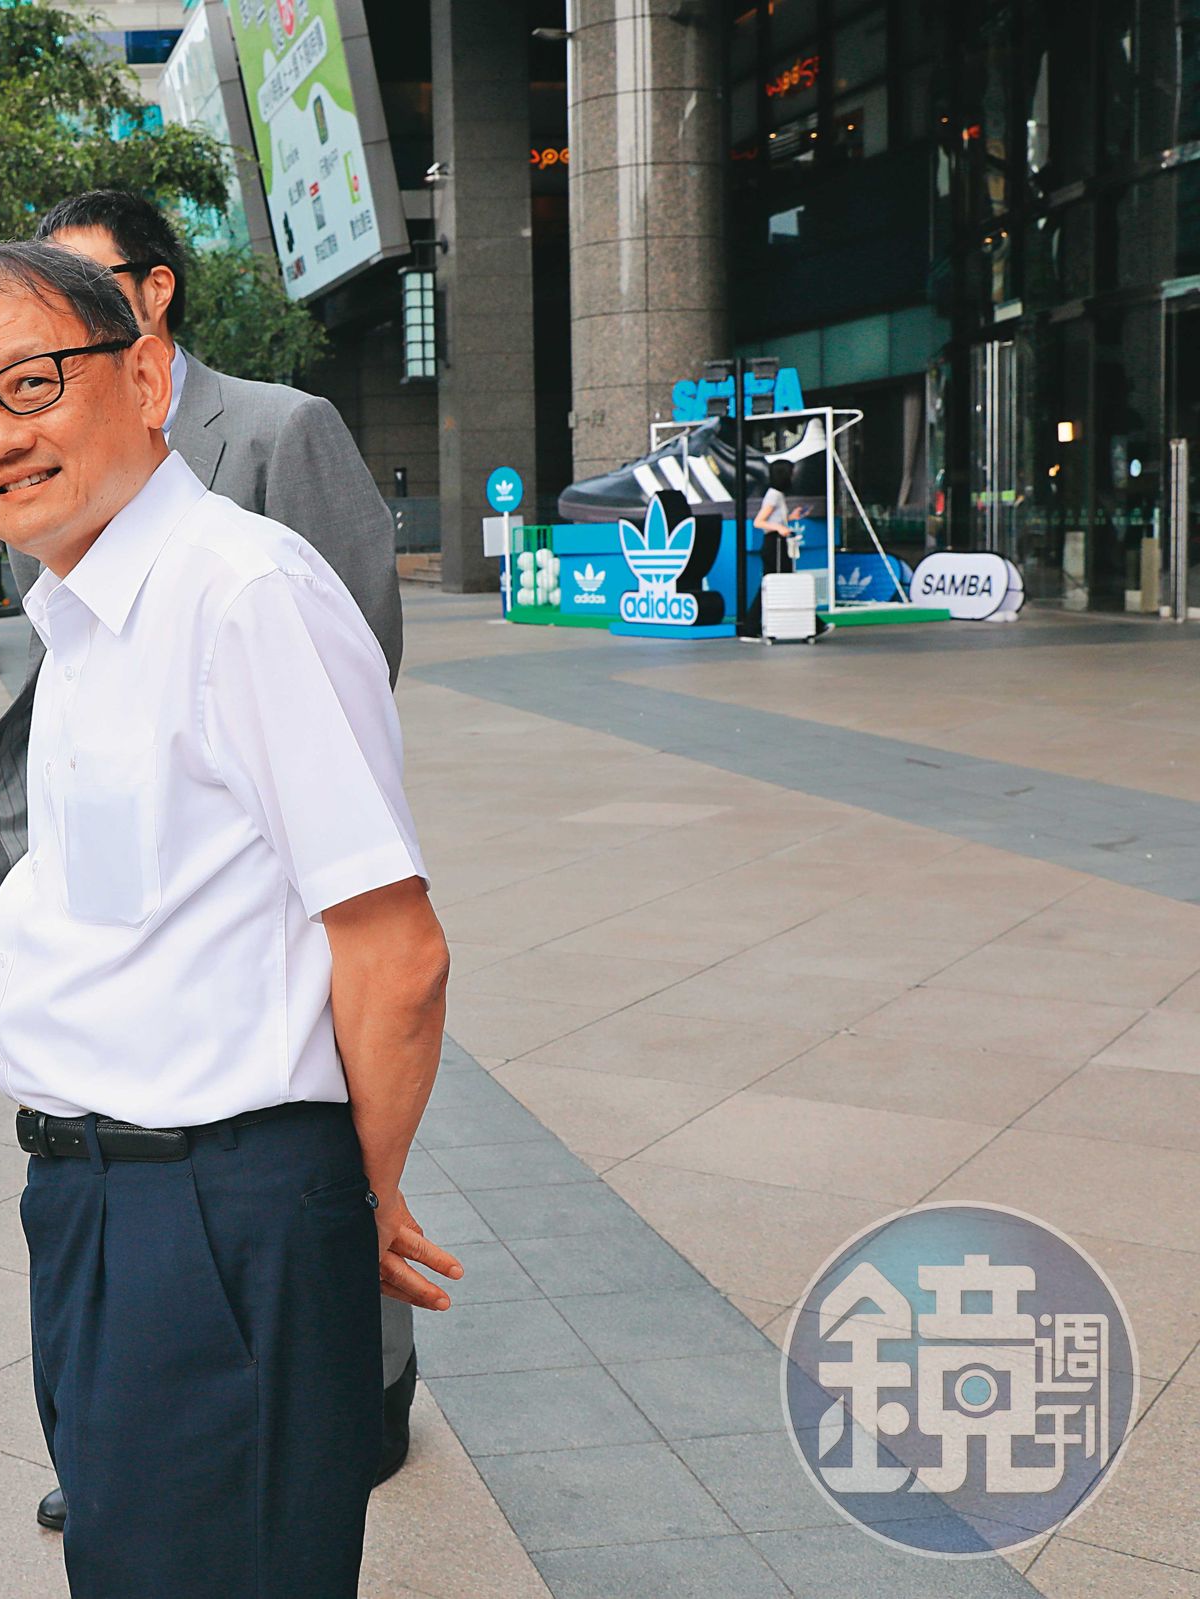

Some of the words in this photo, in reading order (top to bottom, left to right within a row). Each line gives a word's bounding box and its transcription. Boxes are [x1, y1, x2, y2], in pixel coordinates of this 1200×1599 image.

[921, 573, 994, 598] SAMBA
[573, 594, 606, 604] adidas
[623, 591, 695, 621] adidas
